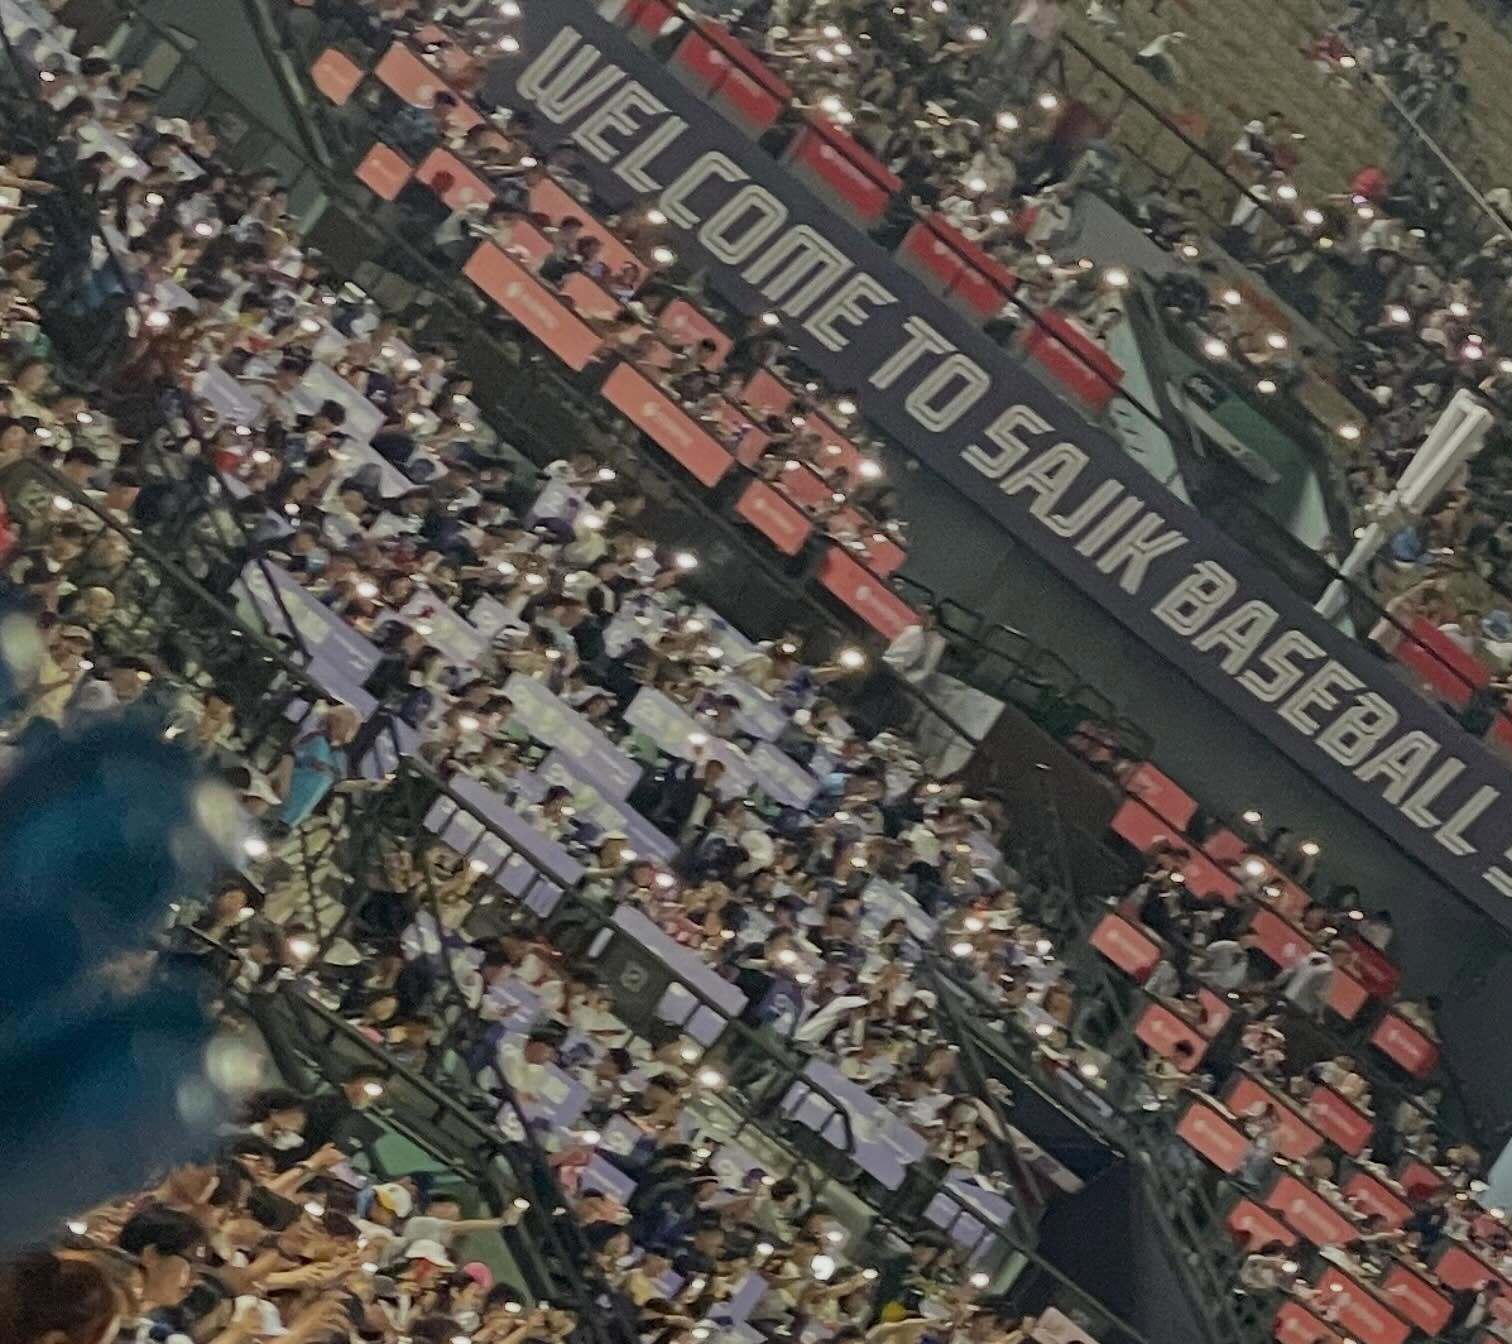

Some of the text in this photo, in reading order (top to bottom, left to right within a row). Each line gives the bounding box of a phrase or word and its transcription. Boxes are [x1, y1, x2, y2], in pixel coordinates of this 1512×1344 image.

[515, 26, 897, 352] WELCOME
[870, 316, 990, 432] TO
[961, 405, 1188, 594] SAJIK
[1152, 561, 1500, 856] BASEBALL
